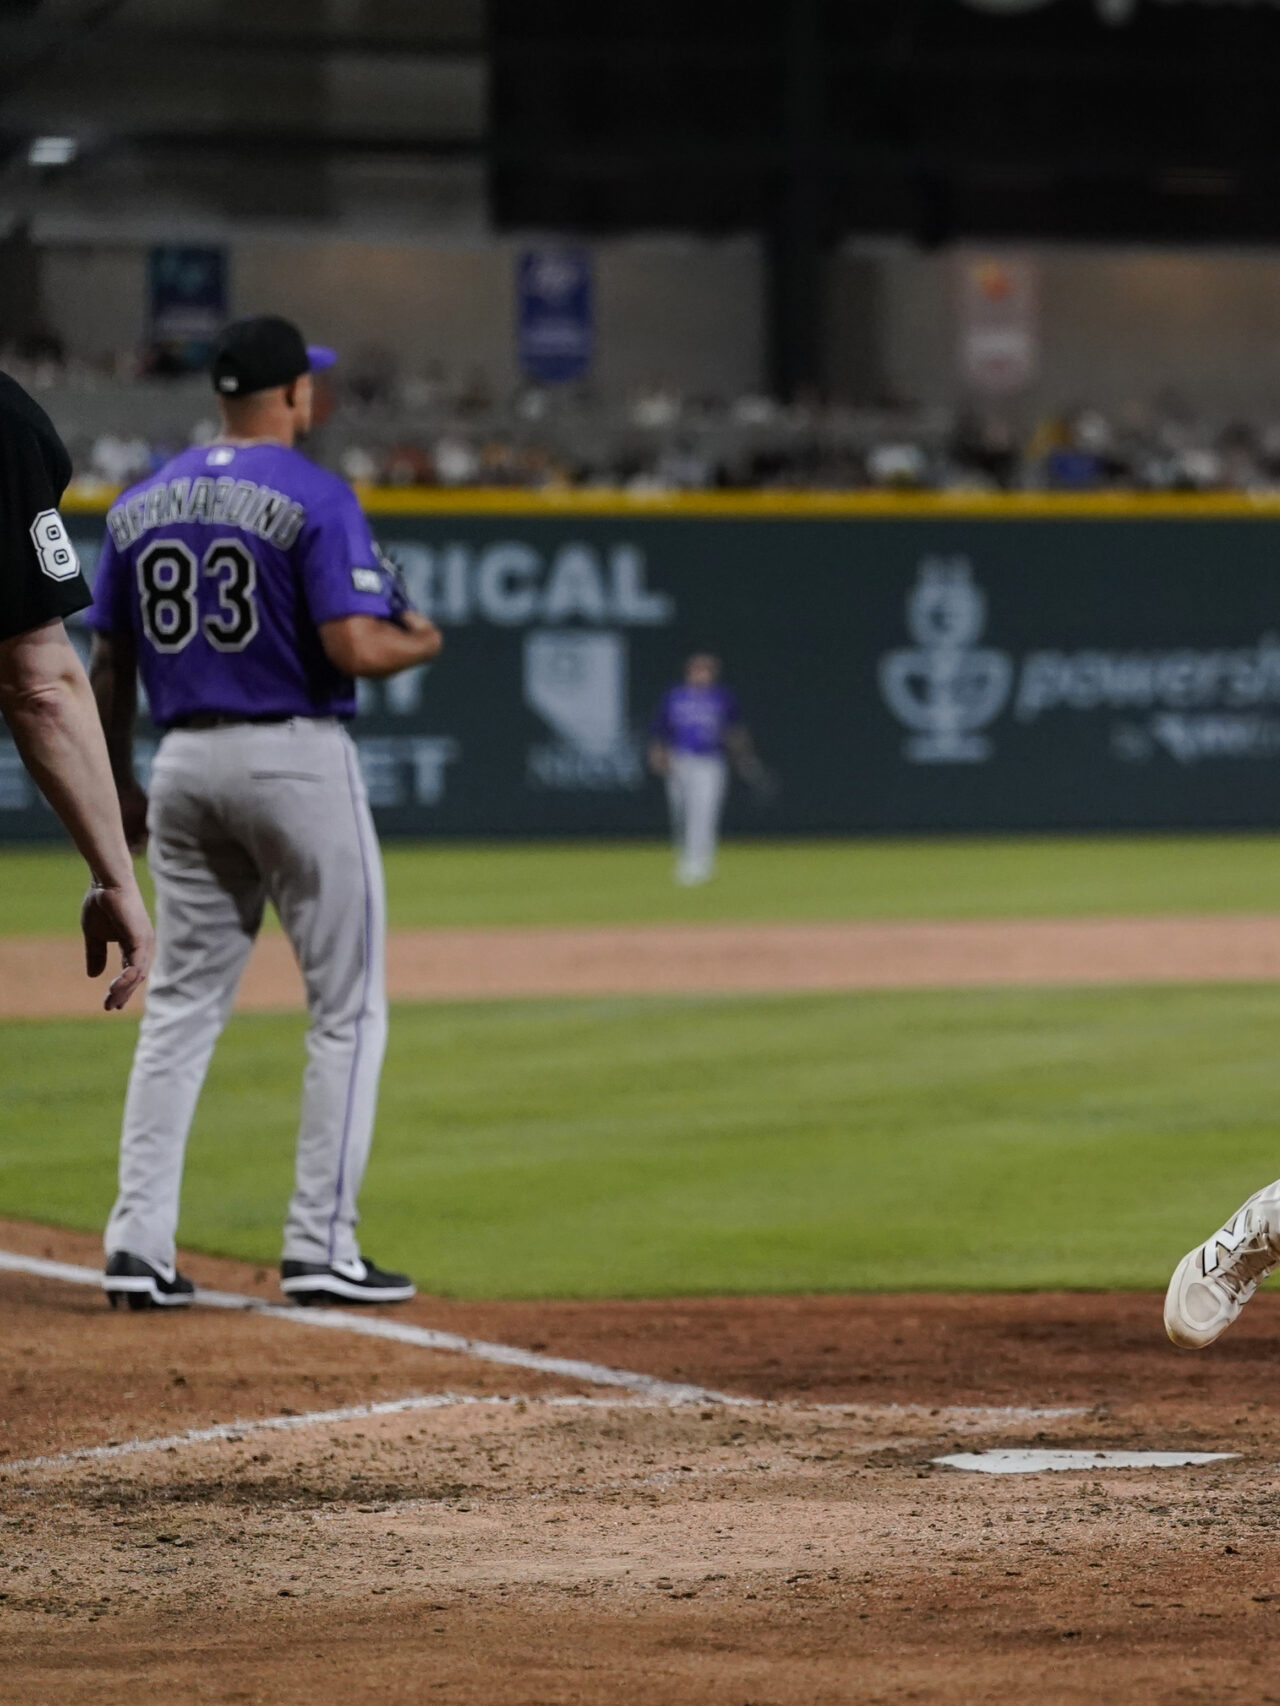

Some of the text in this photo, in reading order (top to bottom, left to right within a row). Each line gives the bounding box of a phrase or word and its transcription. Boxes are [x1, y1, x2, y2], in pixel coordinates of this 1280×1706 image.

[30, 508, 81, 582] 8
[106, 476, 305, 553] BERNARDINO
[136, 538, 260, 654] 83
